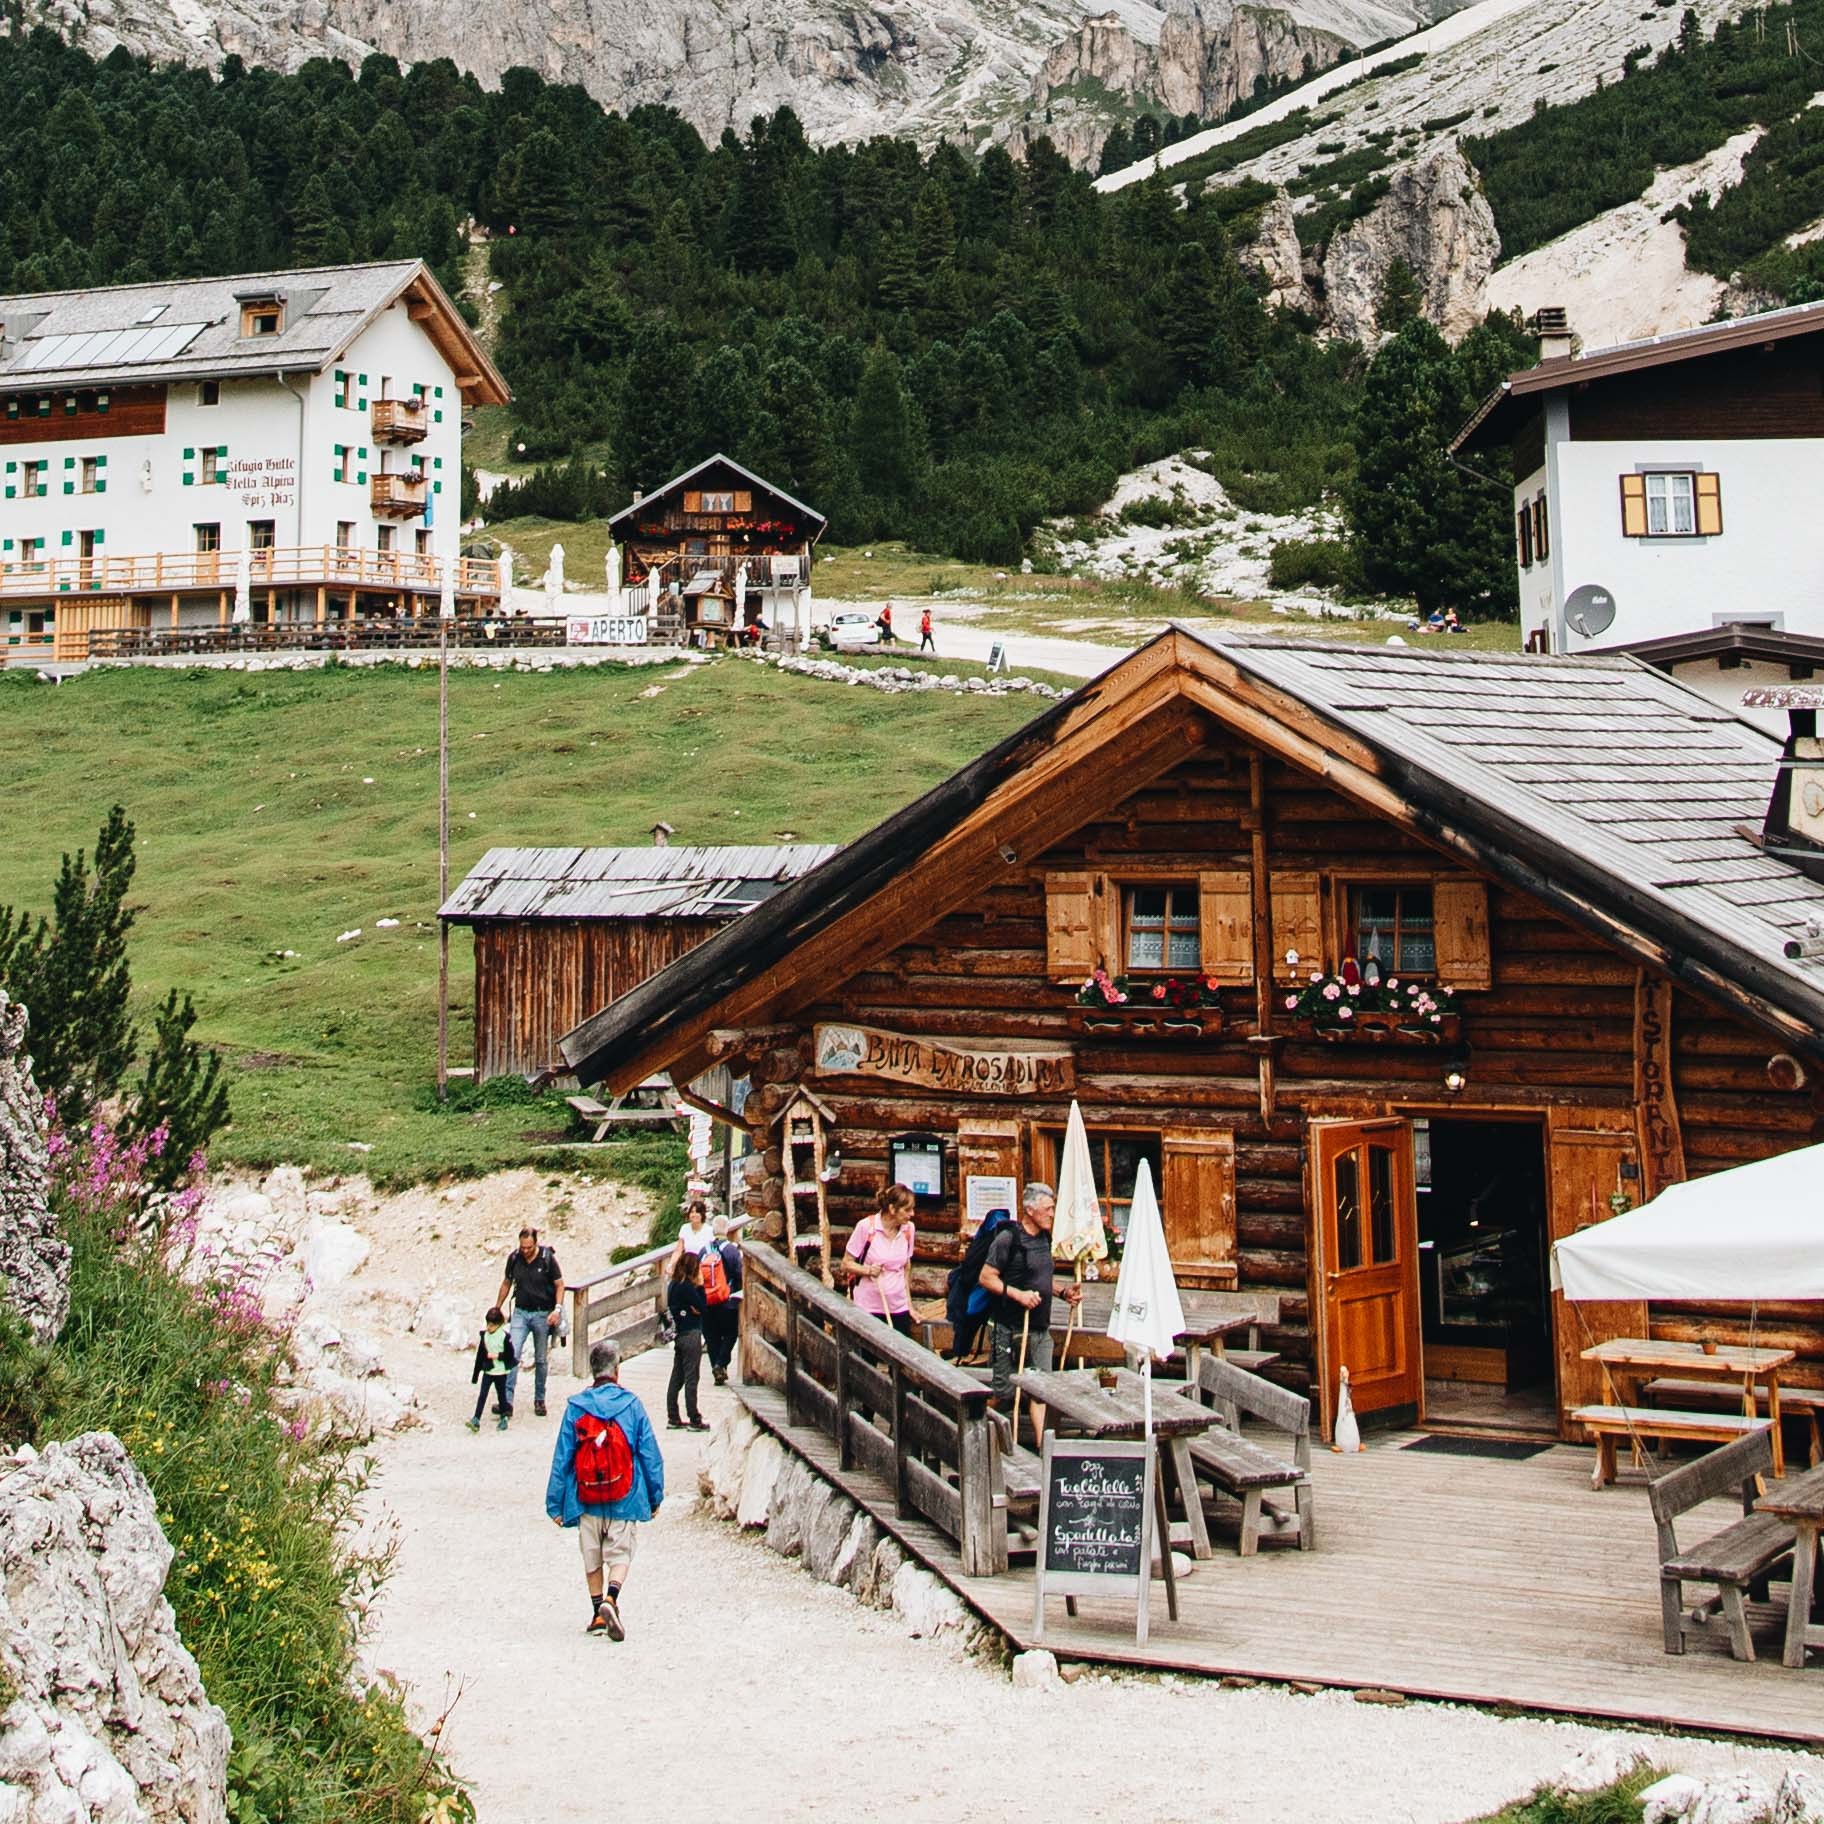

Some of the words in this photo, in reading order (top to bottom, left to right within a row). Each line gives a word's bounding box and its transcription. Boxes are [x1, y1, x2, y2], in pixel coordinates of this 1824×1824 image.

[225, 476, 257, 490] Stella
[261, 475, 295, 490] Alpina
[241, 493, 266, 508] Spiz
[270, 492, 294, 507] Piaz
[592, 618, 644, 641] APERTO
